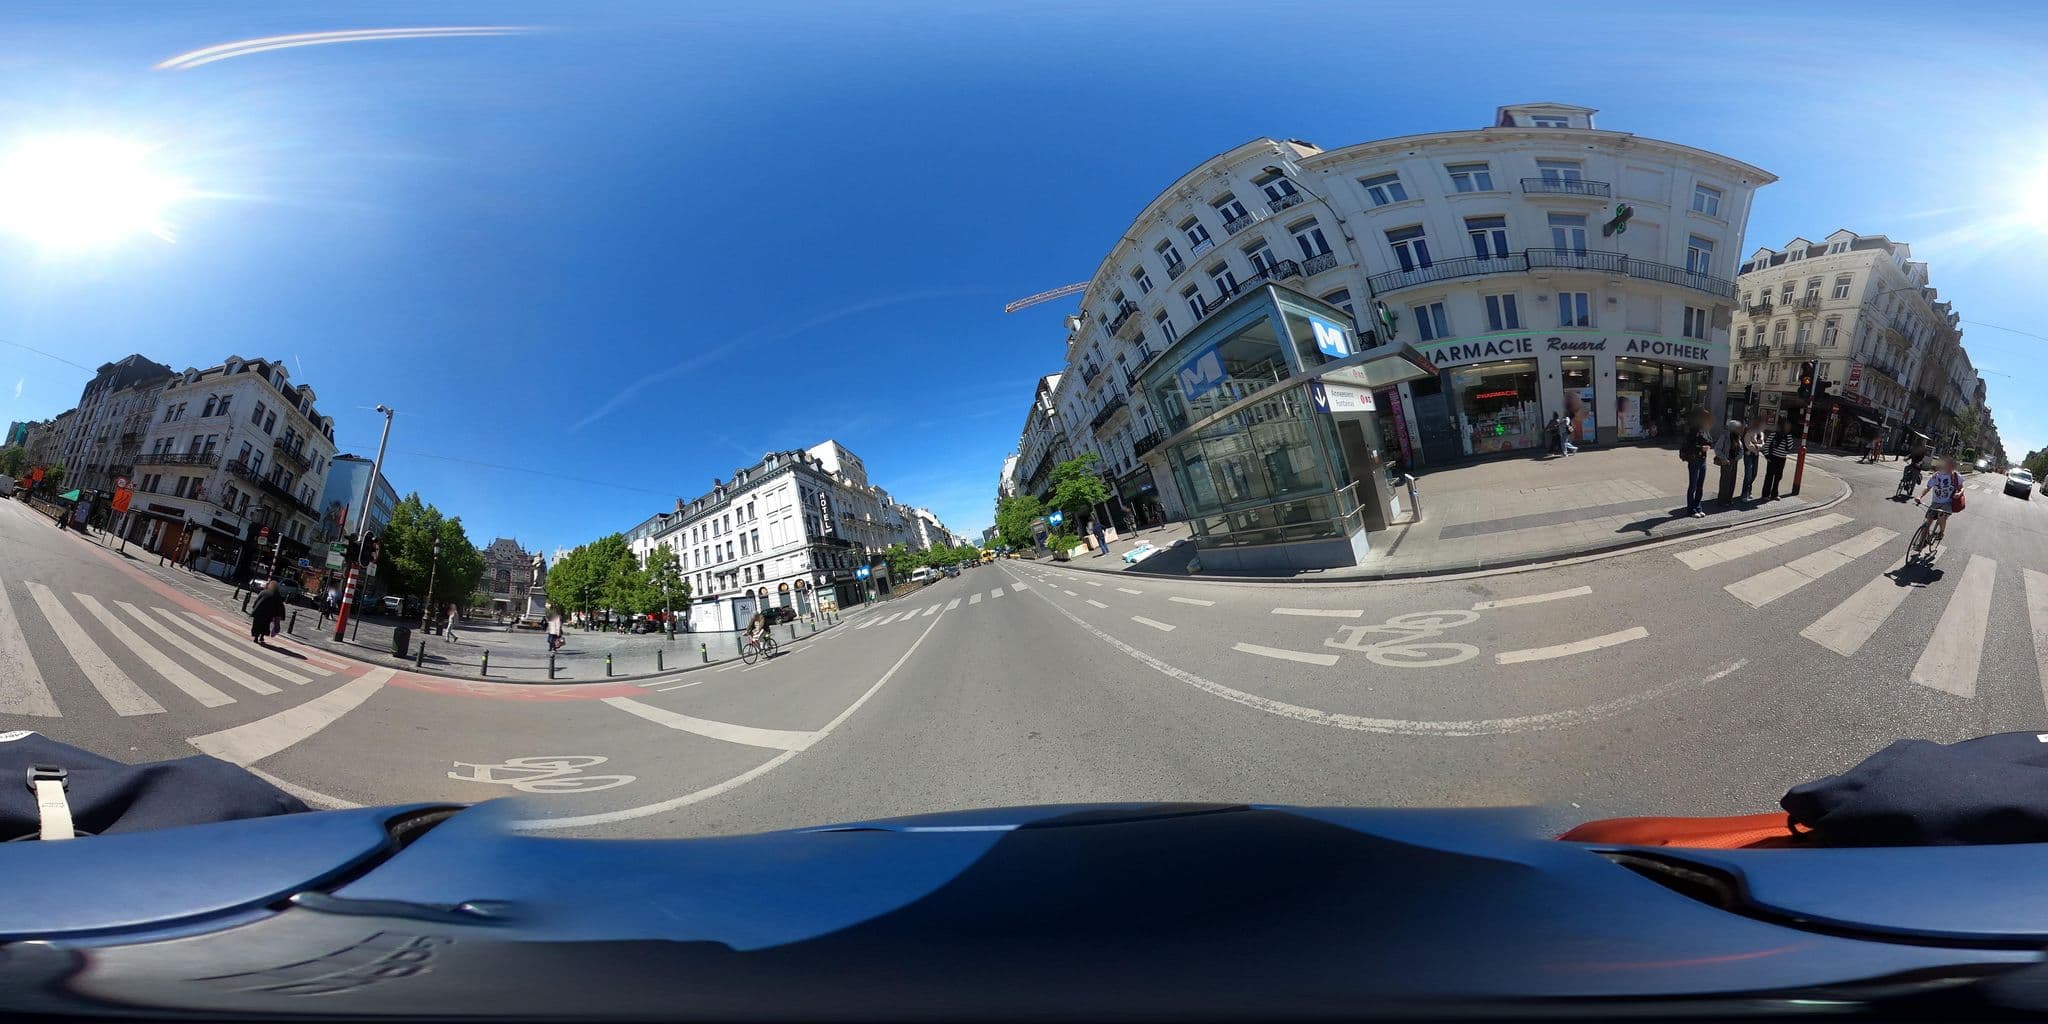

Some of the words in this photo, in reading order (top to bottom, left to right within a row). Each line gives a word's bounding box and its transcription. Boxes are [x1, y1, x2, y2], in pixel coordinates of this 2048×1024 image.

[1312, 321, 1348, 355] M
[1425, 338, 1532, 364] ARMACIE
[1546, 337, 1607, 351] Rouard
[1626, 339, 1709, 361] APOTHEEK
[1180, 350, 1223, 396] M
[819, 491, 832, 529] HOTEL
